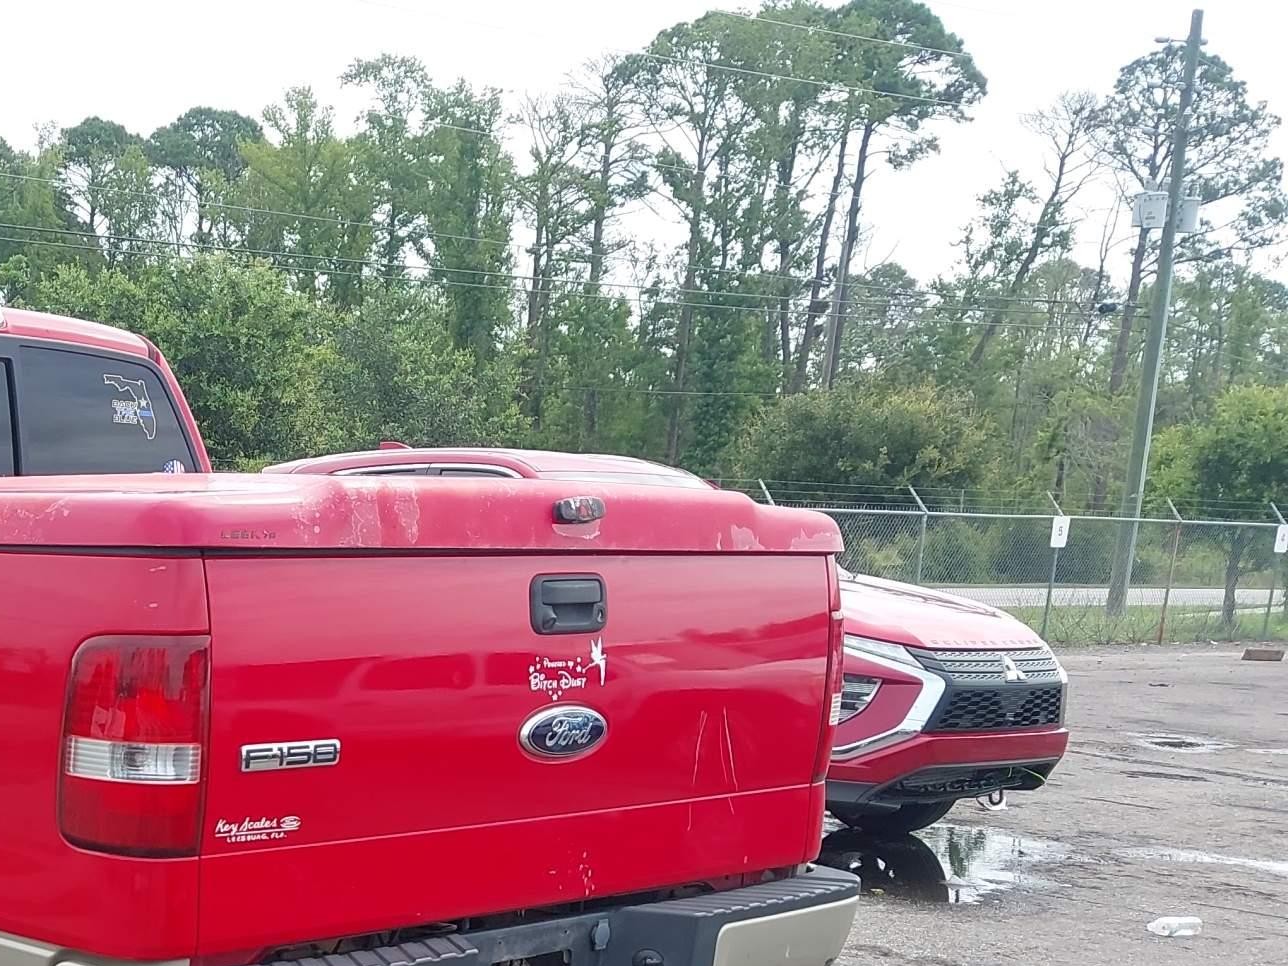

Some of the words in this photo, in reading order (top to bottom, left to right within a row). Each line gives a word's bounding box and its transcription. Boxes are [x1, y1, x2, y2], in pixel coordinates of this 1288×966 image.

[545, 716, 593, 747] Ford
[215, 819, 237, 835] Key
[239, 816, 278, 832] Scales
